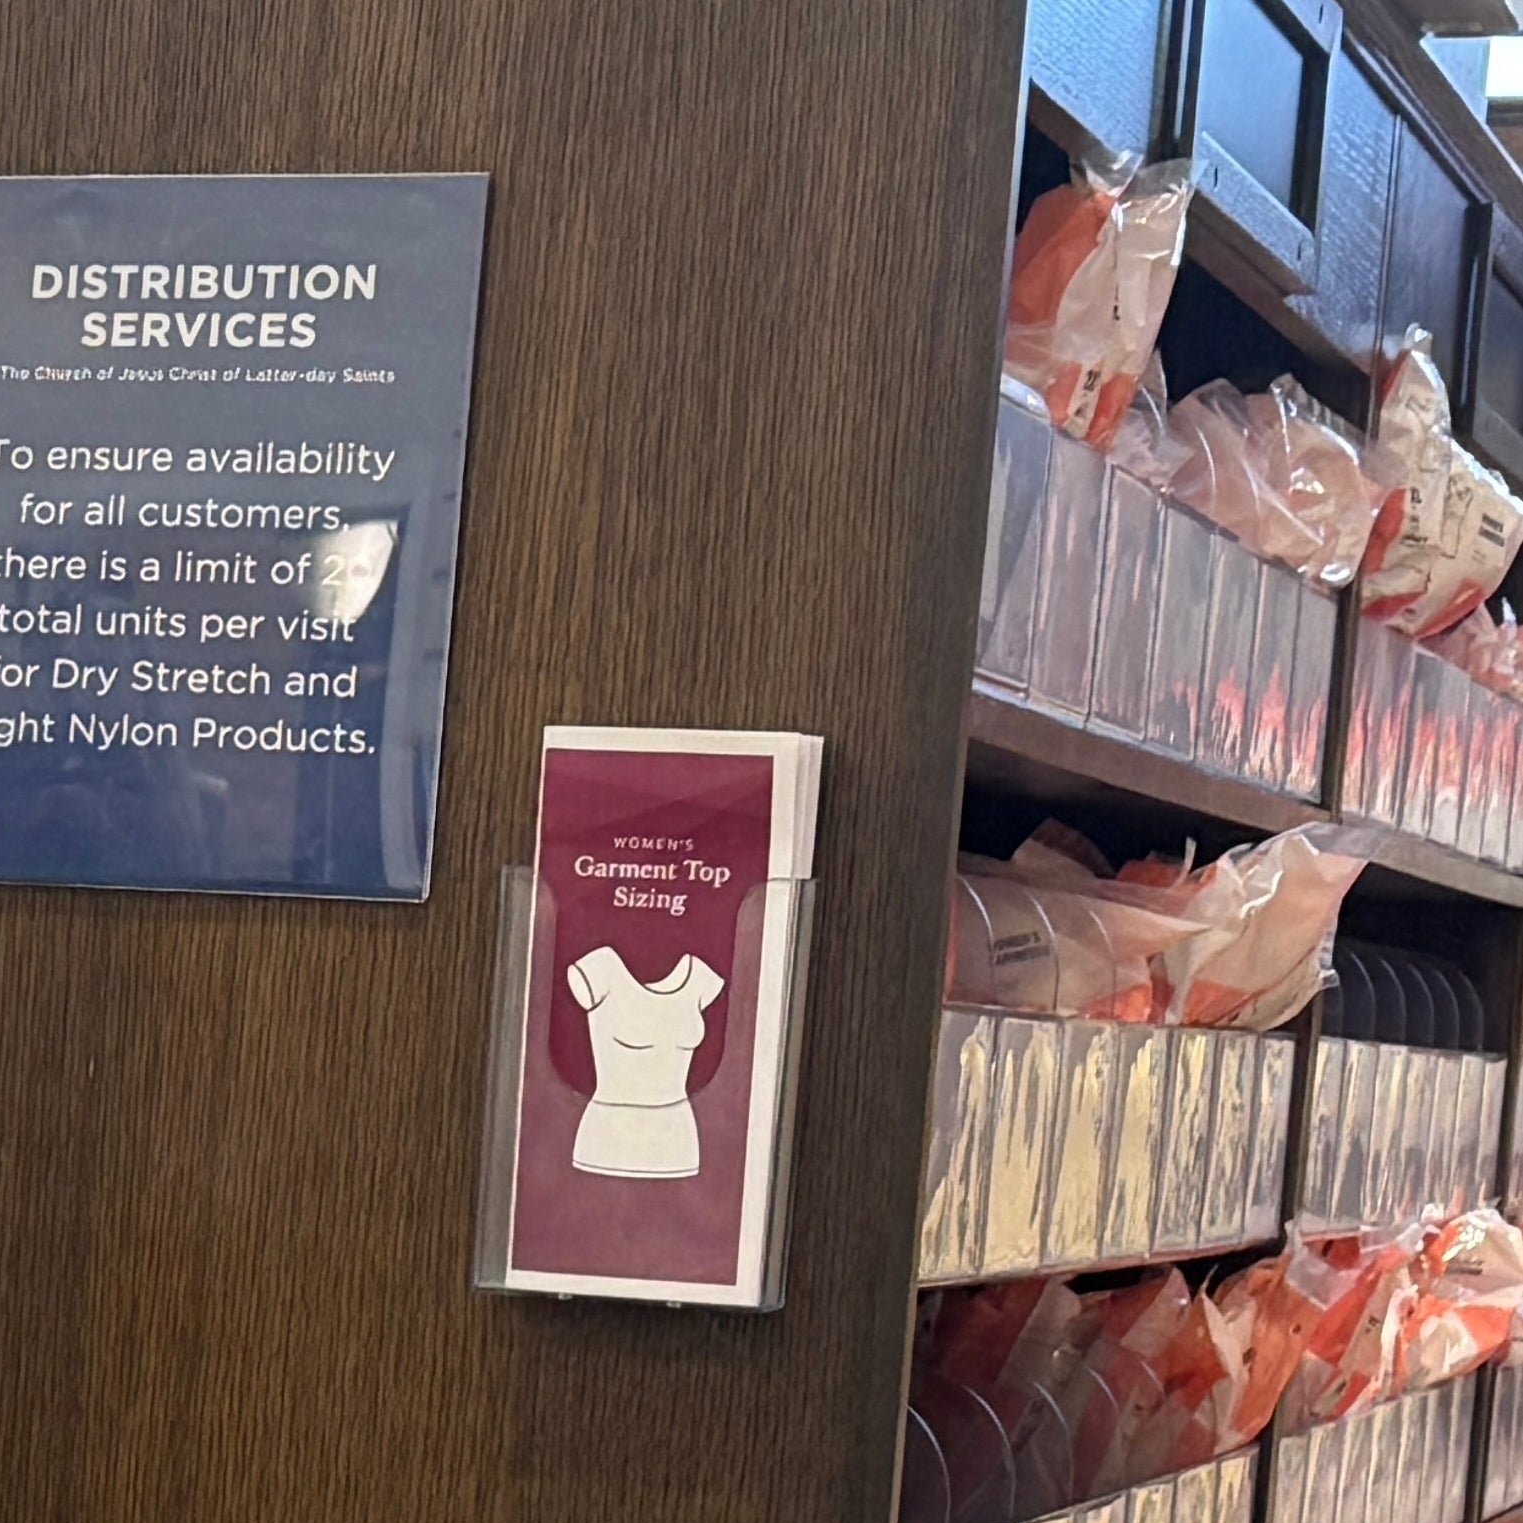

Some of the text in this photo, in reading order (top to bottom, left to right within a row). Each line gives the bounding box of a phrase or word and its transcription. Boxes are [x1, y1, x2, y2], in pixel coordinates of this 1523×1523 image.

[31, 264, 376, 300] DISTRIBUTION
[80, 312, 318, 348] SERVICES
[1, 365, 395, 384] The Church of Jesus Christ of Latter-day Saints
[47, 446, 173, 472] ensure
[186, 443, 395, 480] availability
[20, 494, 72, 526] for
[84, 495, 125, 527] all
[100, 551, 127, 581] is
[139, 557, 161, 582] a
[175, 552, 258, 584] limit
[271, 553, 312, 585] of
[96, 606, 186, 638] units
[200, 614, 265, 642] per
[277, 610, 356, 642] visit
[52, 660, 118, 696] Dry
[131, 660, 271, 696] Stretch
[284, 664, 358, 699] and
[68, 713, 179, 750] Nylon
[193, 717, 376, 754] Products.
[613, 836, 694, 852] WOMEN'S
[574, 855, 732, 889] Garment Top
[613, 886, 688, 916] Sizing
